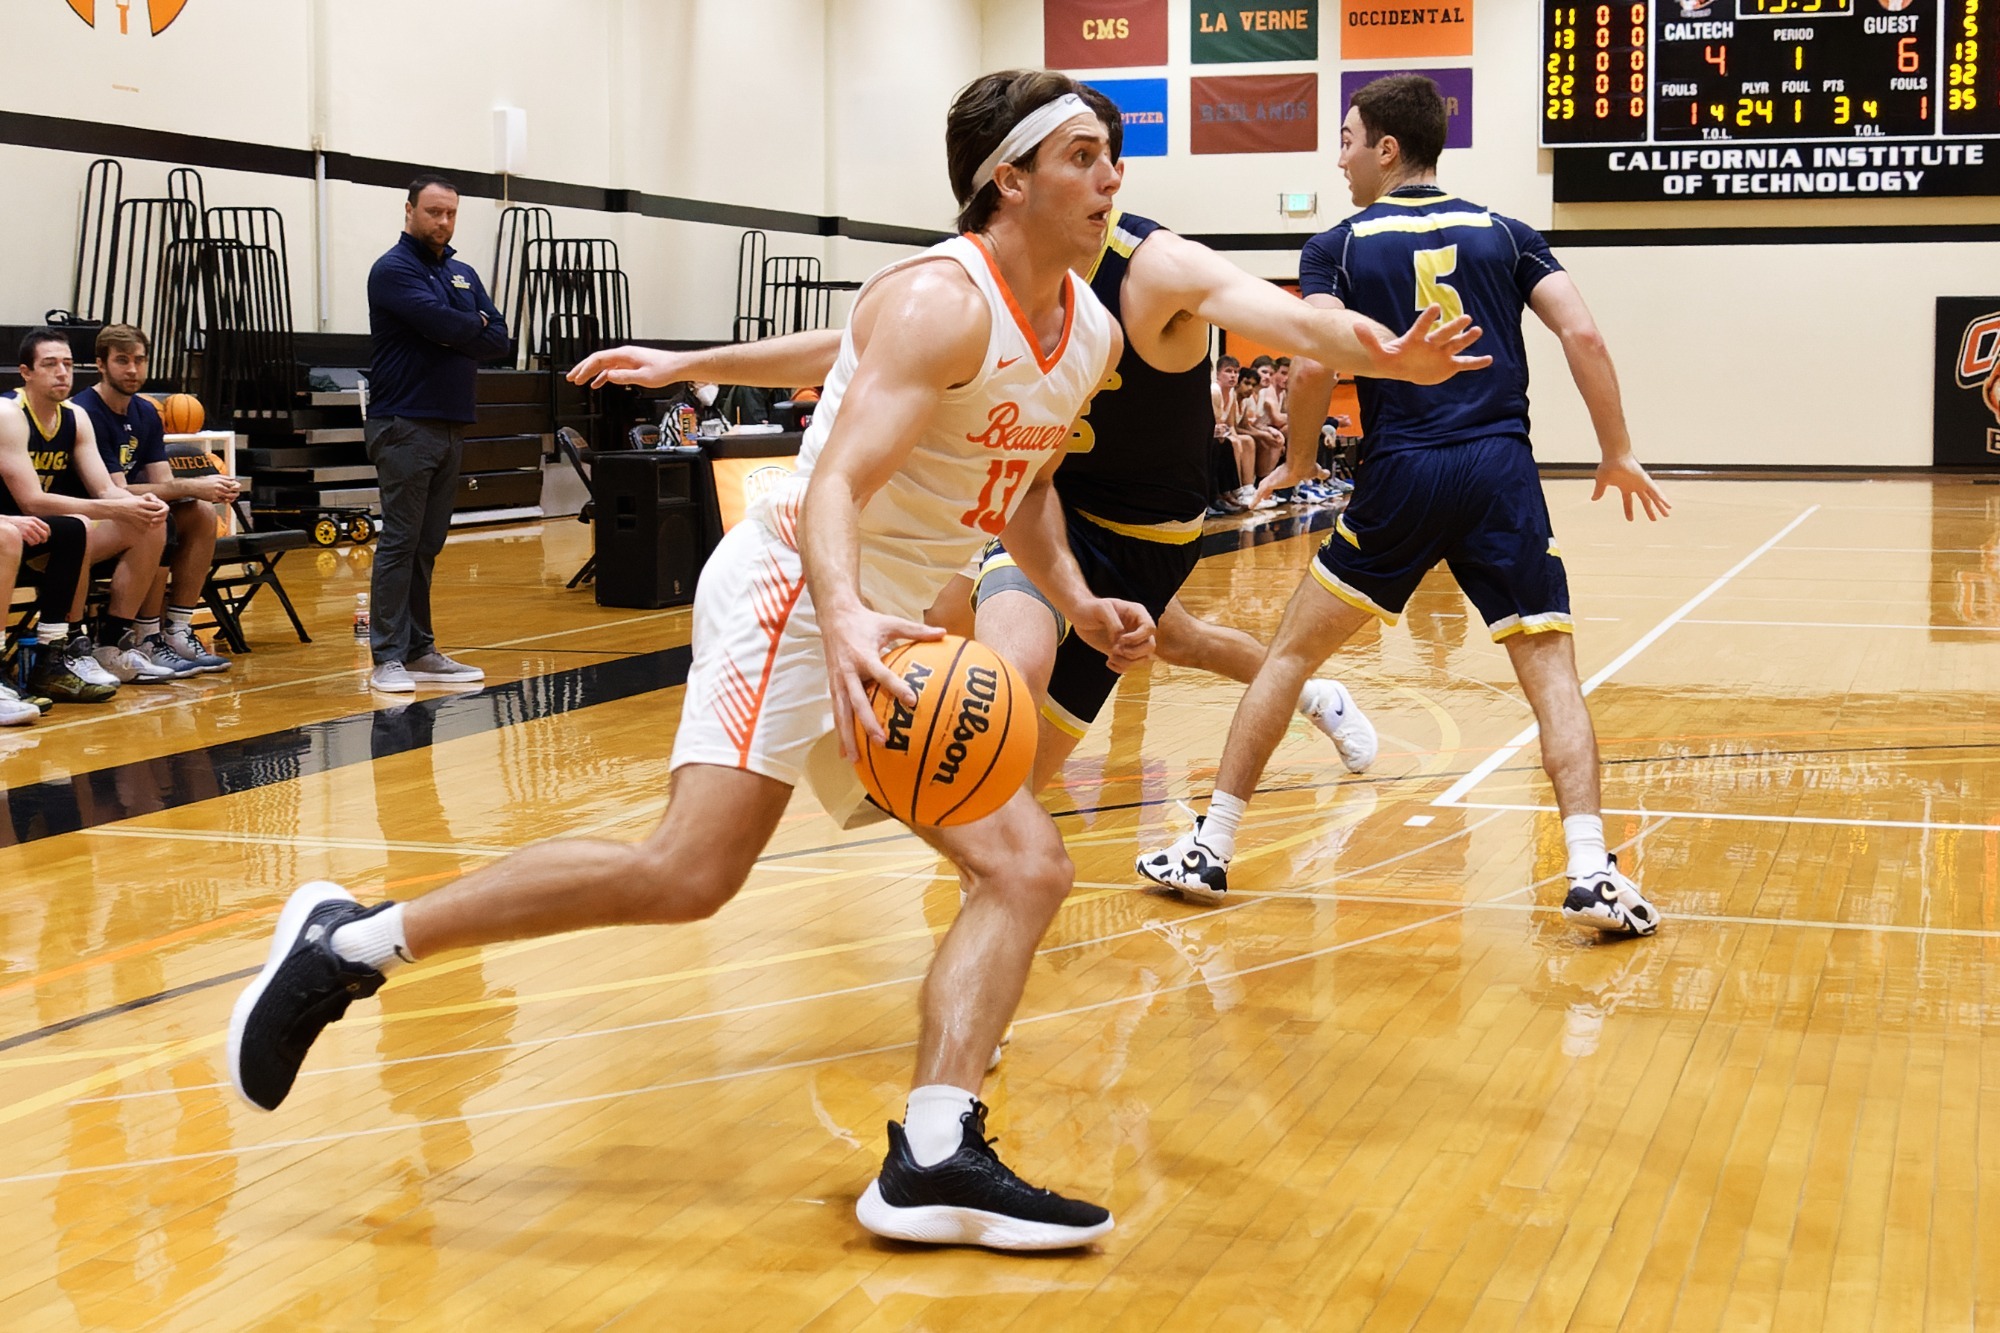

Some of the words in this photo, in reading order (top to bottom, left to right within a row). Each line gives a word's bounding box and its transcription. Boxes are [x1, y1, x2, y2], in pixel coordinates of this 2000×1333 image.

[1199, 13, 1229, 33] LA
[1239, 9, 1308, 32] VERNE
[1349, 7, 1465, 27] OCCIDENTAL
[1555, 9, 1575, 25] 11
[1597, 5, 1610, 26] 0
[1631, 4, 1644, 24] 0
[1864, 16, 1918, 34] GUEST
[1963, 15, 1978, 37] 5
[1082, 18, 1130, 40] CMS
[1555, 29, 1575, 49] 13
[1596, 27, 1609, 48] 0
[1631, 26, 1644, 48] 0
[1665, 22, 1733, 40] CALTECH
[1774, 28, 1813, 40] PERIOD
[1548, 53, 1574, 74] 21
[1596, 51, 1609, 72] 0
[1631, 50, 1644, 71] 0
[1705, 46, 1725, 75] 4
[1796, 46, 1802, 70] 1
[1898, 38, 1918, 72] 6
[1956, 40, 1977, 62] 13
[1548, 75, 1574, 96] 22
[1596, 74, 1609, 94] 0
[1631, 73, 1644, 93] 0
[1891, 78, 1927, 90] FOULS
[1950, 63, 1977, 85] 32
[1662, 84, 1697, 96] FOULS
[1742, 82, 1769, 94] PLYR
[1782, 81, 1810, 93] FOUL
[1823, 80, 1844, 91] PTS
[1547, 99, 1574, 119] 23
[1596, 98, 1608, 118] 0
[1630, 97, 1644, 117] 0
[1863, 101, 1877, 118] 4
[1921, 96, 1927, 119] 1
[1949, 88, 1976, 110] 35
[1199, 101, 1309, 122] REDLANDS
[1691, 103, 1697, 124] 1
[1710, 105, 1724, 121] 4
[1736, 99, 1772, 126] 24
[1795, 100, 1801, 123] 1
[1834, 96, 1849, 124] 3
[1609, 150, 1802, 171] CALIFORNIA
[1814, 145, 1983, 167] INSTITUTE
[1664, 175, 1702, 194] OF
[1712, 172, 1924, 193] TECHNOLOGY
[1414, 243, 1465, 333] 5
[965, 400, 1068, 452] Beaver
[931, 664, 998, 786] Wilson
